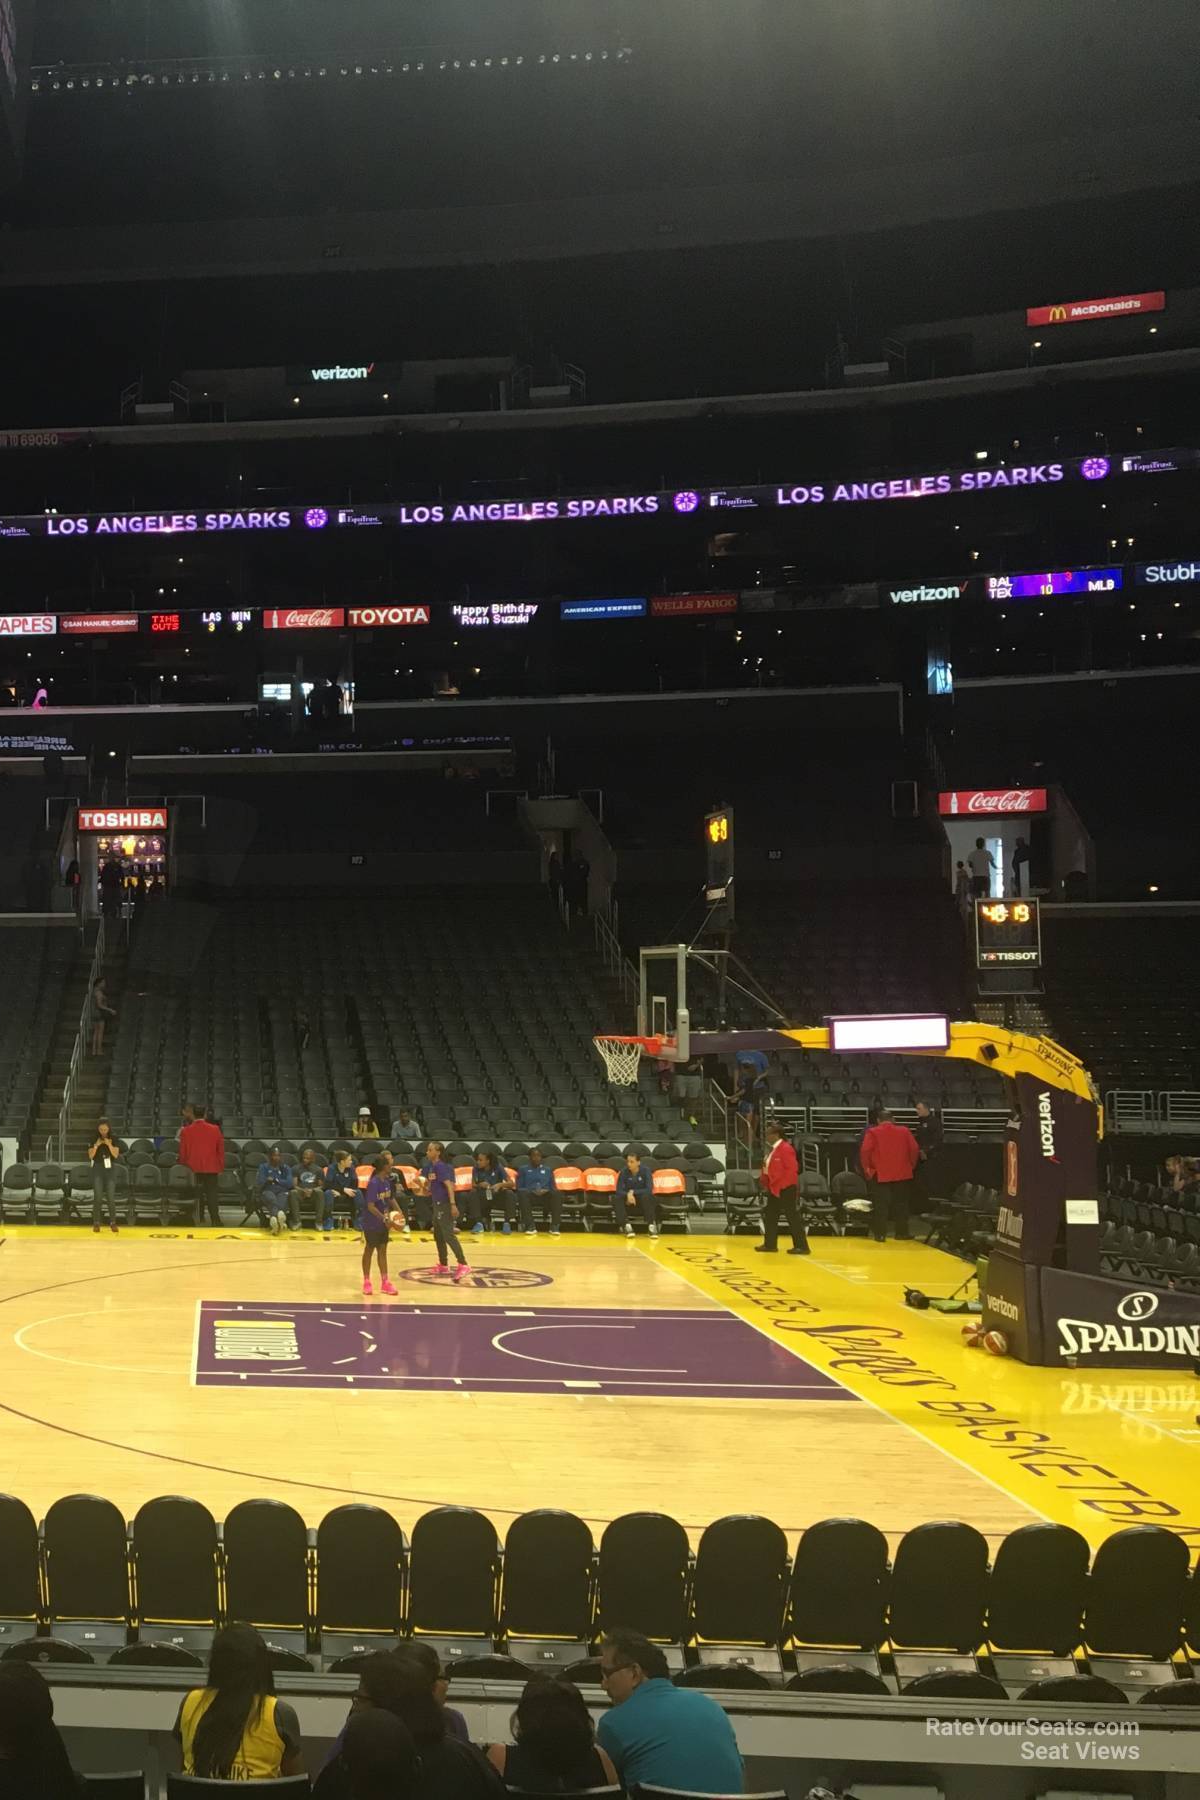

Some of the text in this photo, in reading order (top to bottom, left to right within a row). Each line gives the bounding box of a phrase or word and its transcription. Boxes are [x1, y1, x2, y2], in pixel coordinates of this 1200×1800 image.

[1071, 299, 1141, 316] McDonald's
[312, 364, 366, 380] verizon
[20, 432, 59, 446] 69050
[777, 463, 1063, 505] LOS ANGELES SPARKS
[401, 496, 659, 523] LOS ANGELES SPARKS
[47, 510, 290, 535] LOS ANGELES SPARKS
[989, 576, 1013, 587] BAL
[1088, 580, 1114, 592] MLB
[890, 584, 959, 604] verizon
[989, 585, 1053, 599] TEX 10
[453, 603, 538, 616] Happy Birthday
[653, 599, 736, 611] WELLS FARGO
[202, 611, 250, 621] LAS MIN
[350, 607, 428, 625] TOYOTA
[493, 613, 529, 624] Suzuki
[152, 622, 179, 631] OUTS
[81, 812, 165, 827] TOSHIBA
[998, 952, 1038, 961] TISSOT
[1037, 1042, 1075, 1076] SPALDING
[1038, 1091, 1057, 1157] verizon
[705, 1266, 821, 1313] ANGELES
[987, 1294, 1019, 1322] verizon
